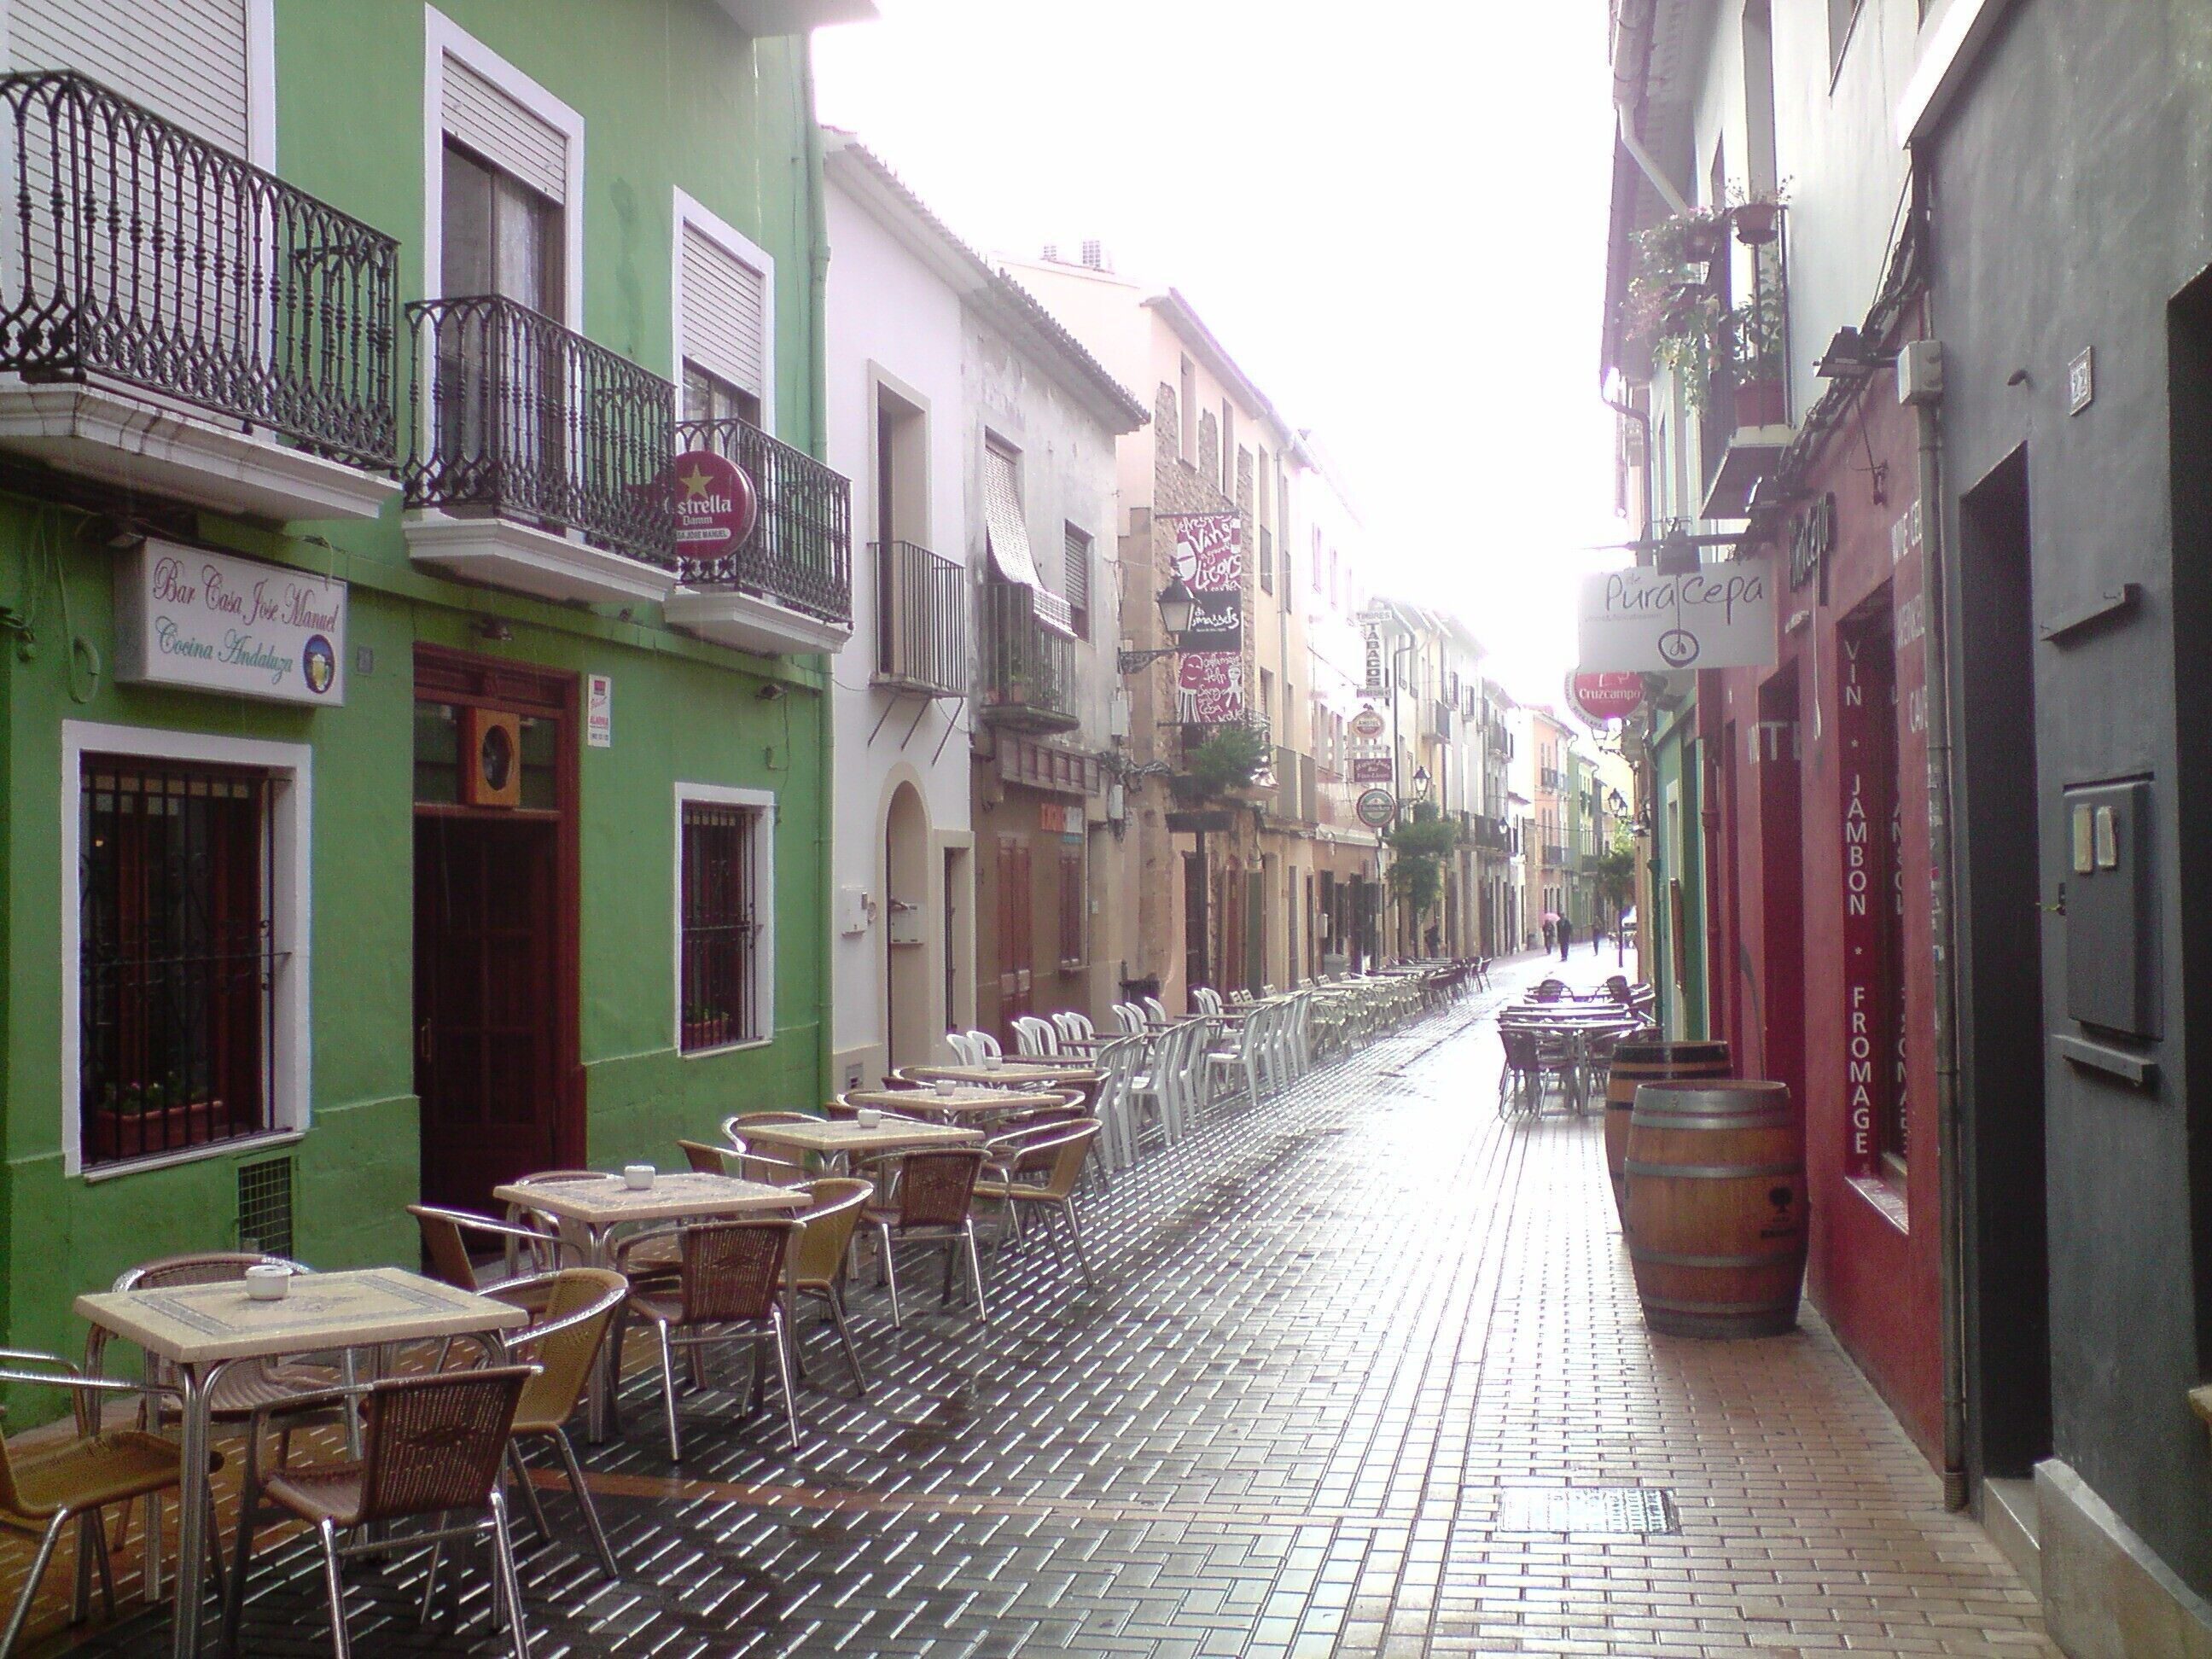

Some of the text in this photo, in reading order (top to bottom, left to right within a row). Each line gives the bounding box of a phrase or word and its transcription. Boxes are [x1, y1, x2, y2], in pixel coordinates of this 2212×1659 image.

[153, 556, 195, 604] Bar
[201, 564, 242, 614] Casa
[281, 582, 339, 633] Manuel
[1606, 573, 1675, 611] Pura
[154, 615, 294, 684] Cocina Andaluza
[1365, 621, 1381, 686] TABACOS
[1579, 688, 1640, 701] Cruzcampo
[1844, 641, 1871, 1154] VIN JAMBON FROMAGE
